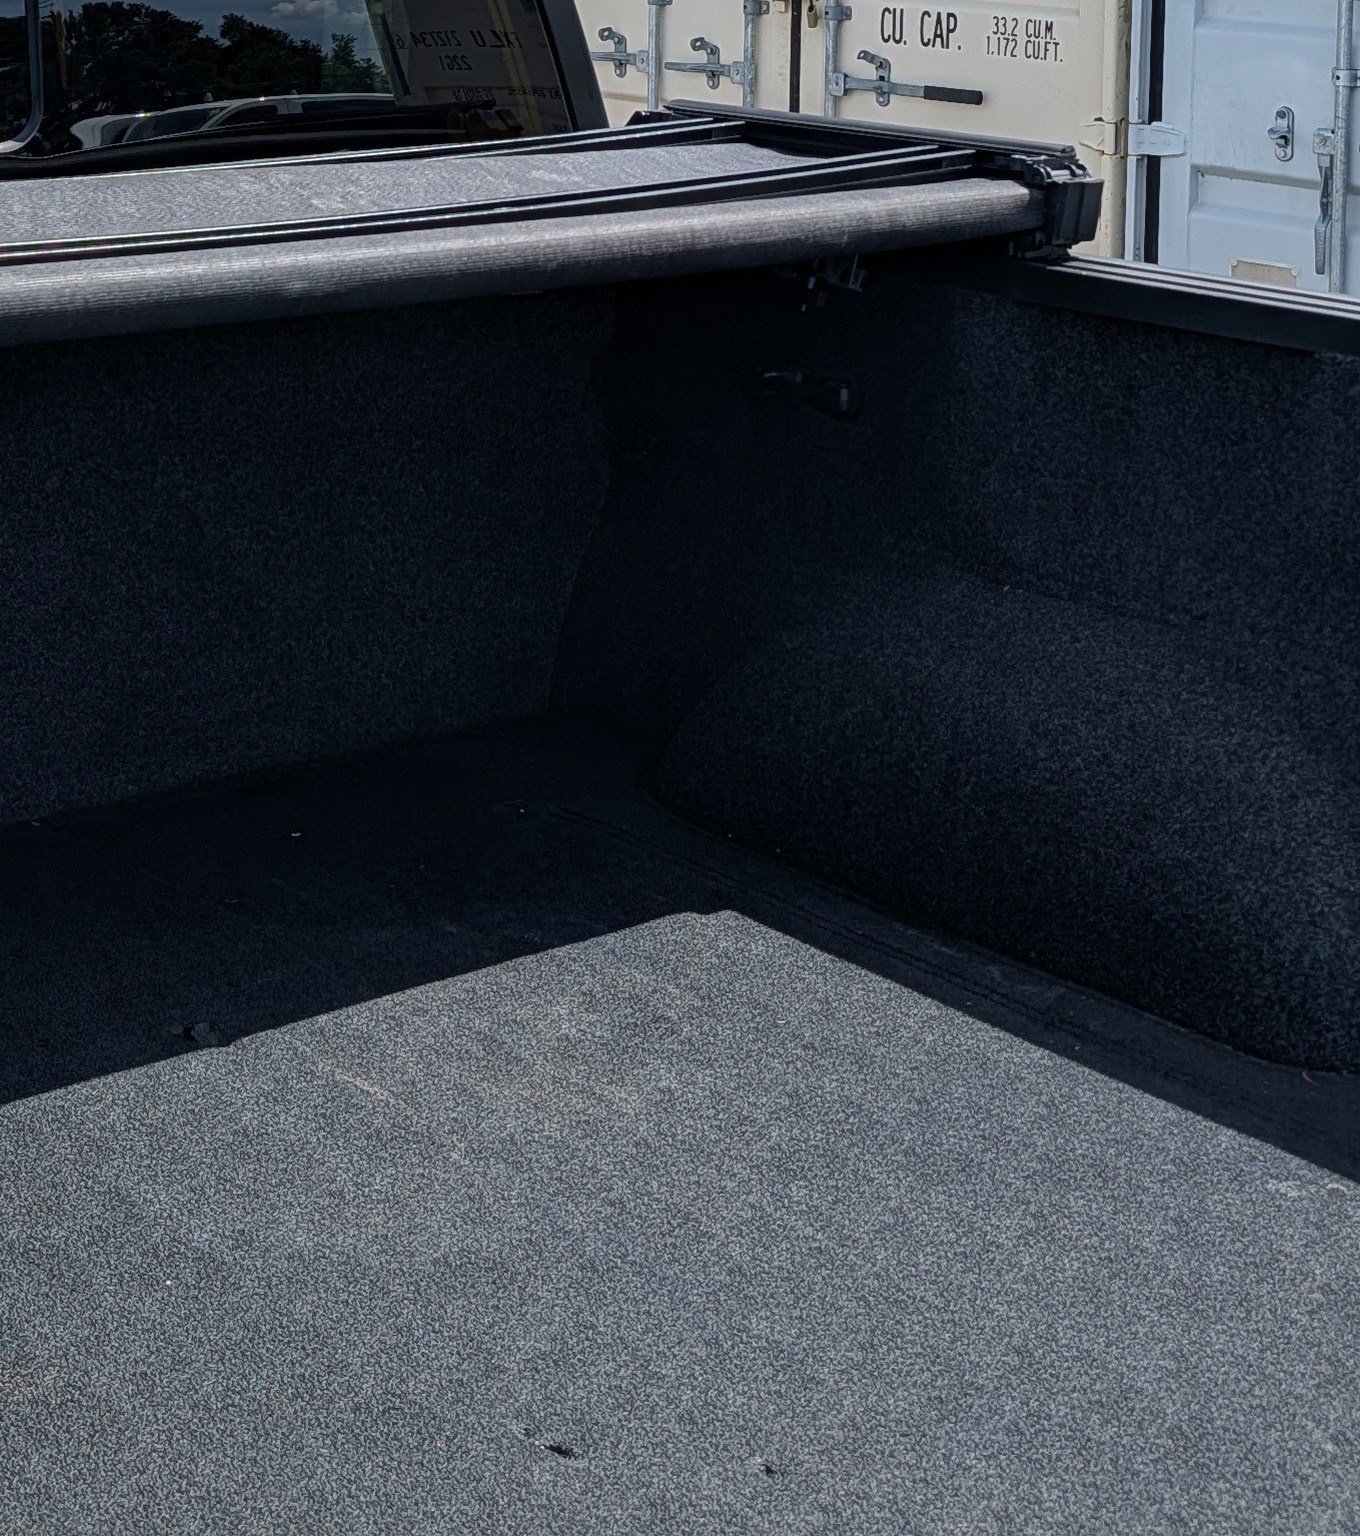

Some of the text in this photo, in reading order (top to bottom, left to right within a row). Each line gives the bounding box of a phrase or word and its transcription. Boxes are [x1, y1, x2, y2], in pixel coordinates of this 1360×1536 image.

[880, 7, 1056, 51] CU. CAP. 33.2 CU.M.
[1024, 40, 1064, 63] CU.FT.
